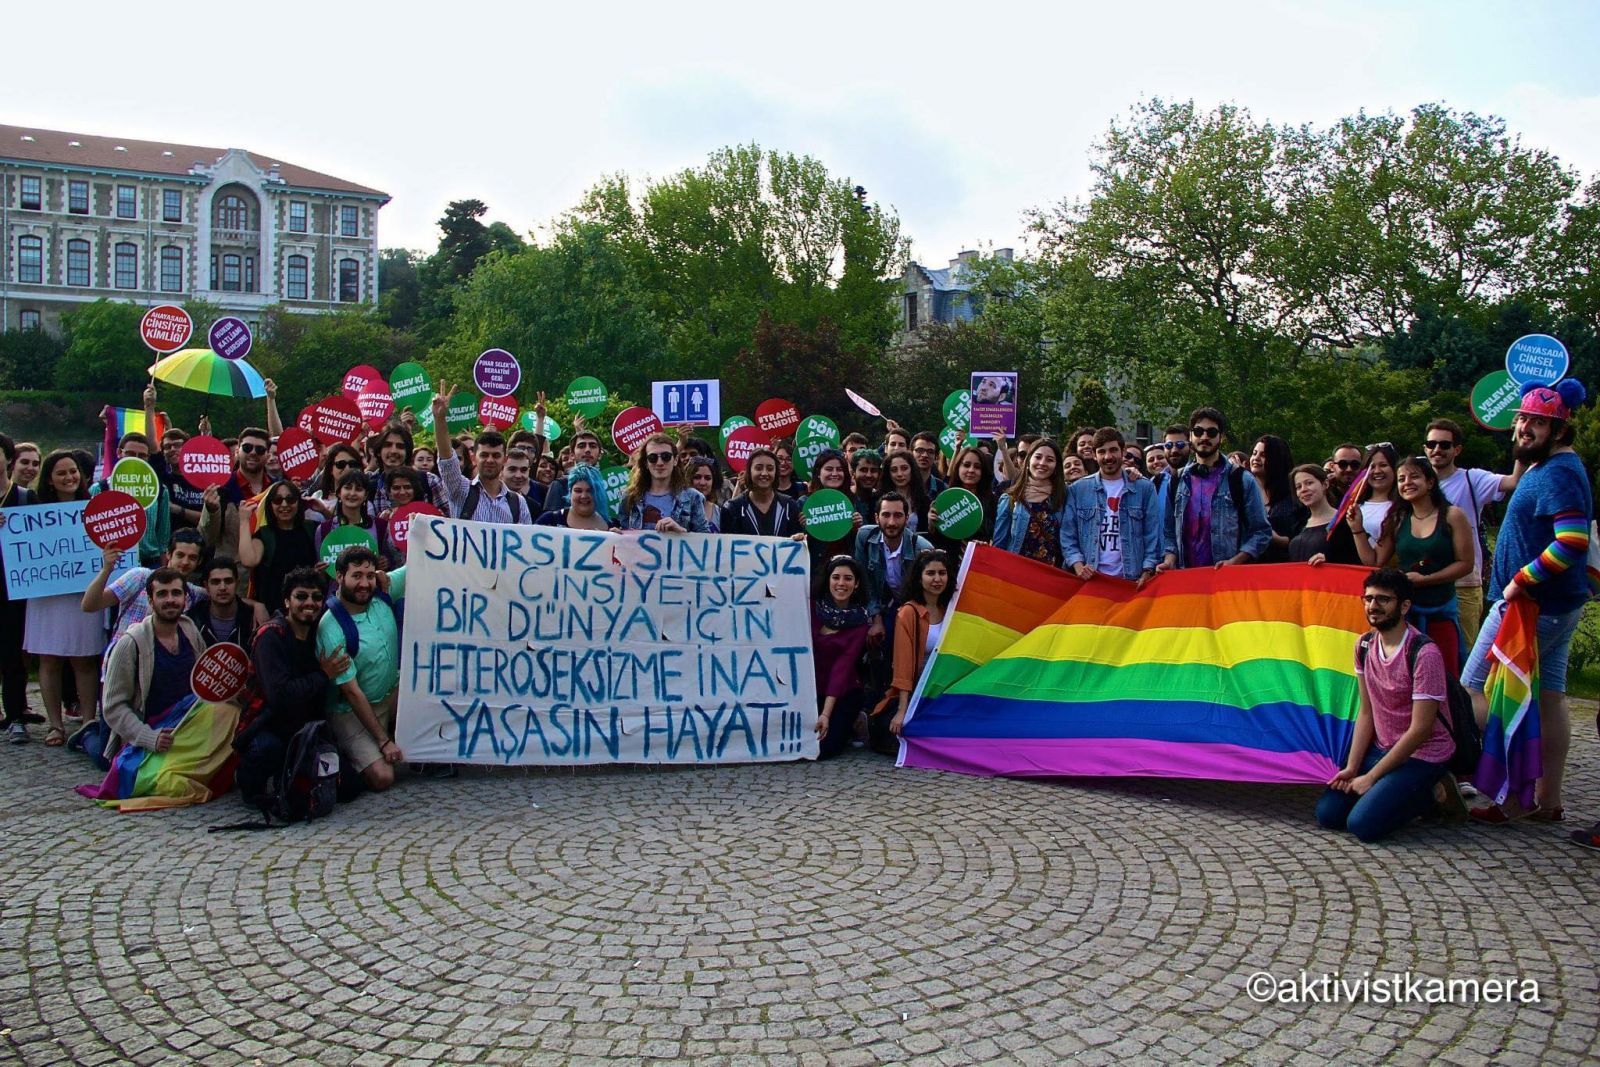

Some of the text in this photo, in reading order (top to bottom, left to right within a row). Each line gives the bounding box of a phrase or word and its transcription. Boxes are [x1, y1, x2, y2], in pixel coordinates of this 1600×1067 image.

[145, 318, 189, 333] CİNSİYET
[150, 311, 187, 324] ANAYASADA
[145, 328, 184, 343] KİMLİĞİ
[214, 321, 234, 339] HUKUK
[1514, 342, 1564, 358] ANAYASADA
[1518, 353, 1554, 368] CİNSEL
[1512, 362, 1557, 379] YÖNELİM
[345, 383, 363, 392] CAN
[347, 375, 368, 386] #TRA
[392, 373, 424, 389] VELEV Kİ
[391, 382, 430, 400] DÖNMEYİZ
[570, 389, 592, 398] VELEV
[1478, 378, 1515, 411] VELEV Kİ
[567, 394, 608, 405] DÖNMEYİZ
[315, 406, 362, 423] ANAYASADA
[448, 406, 469, 415] VELEV
[480, 409, 515, 424] CANDIR
[482, 401, 517, 416] #TRANS
[758, 408, 796, 424] #TRANS
[318, 416, 356, 431] CİNSİYET
[614, 414, 657, 438] ANAYASADA
[760, 415, 799, 431] CANDIR
[807, 418, 836, 439] DÖN
[318, 426, 351, 440] KİMLİĞİ
[622, 423, 656, 444] CİNSİYET
[280, 439, 314, 462] #TRANS
[727, 449, 750, 459] CAN
[183, 453, 231, 465] #TRANS
[282, 448, 319, 472] CANDIR
[183, 463, 232, 475] CANDIR
[116, 472, 152, 484] VELEV Kİ
[85, 502, 140, 525] ANAYASADA
[808, 500, 846, 515] VELEV Kİ
[937, 494, 970, 520] VELEV Kİ
[93, 514, 137, 533] CİNSİYET
[805, 510, 852, 526] DÖNMEYİZ
[939, 500, 979, 532] DÖNMEYİZ
[99, 524, 138, 543] KİMLİĞİ
[425, 519, 606, 572] SINIRSIZ
[636, 533, 806, 577] SINIFSIZ
[10, 560, 86, 589] AÇACAĞIZ
[436, 587, 773, 644] BİR DÜNYA İÇİN
[200, 655, 222, 676] HER
[412, 641, 809, 703] HETEROSEKSİZME İNAT
[440, 697, 802, 764] YAŞASIN HAYAT!!!
